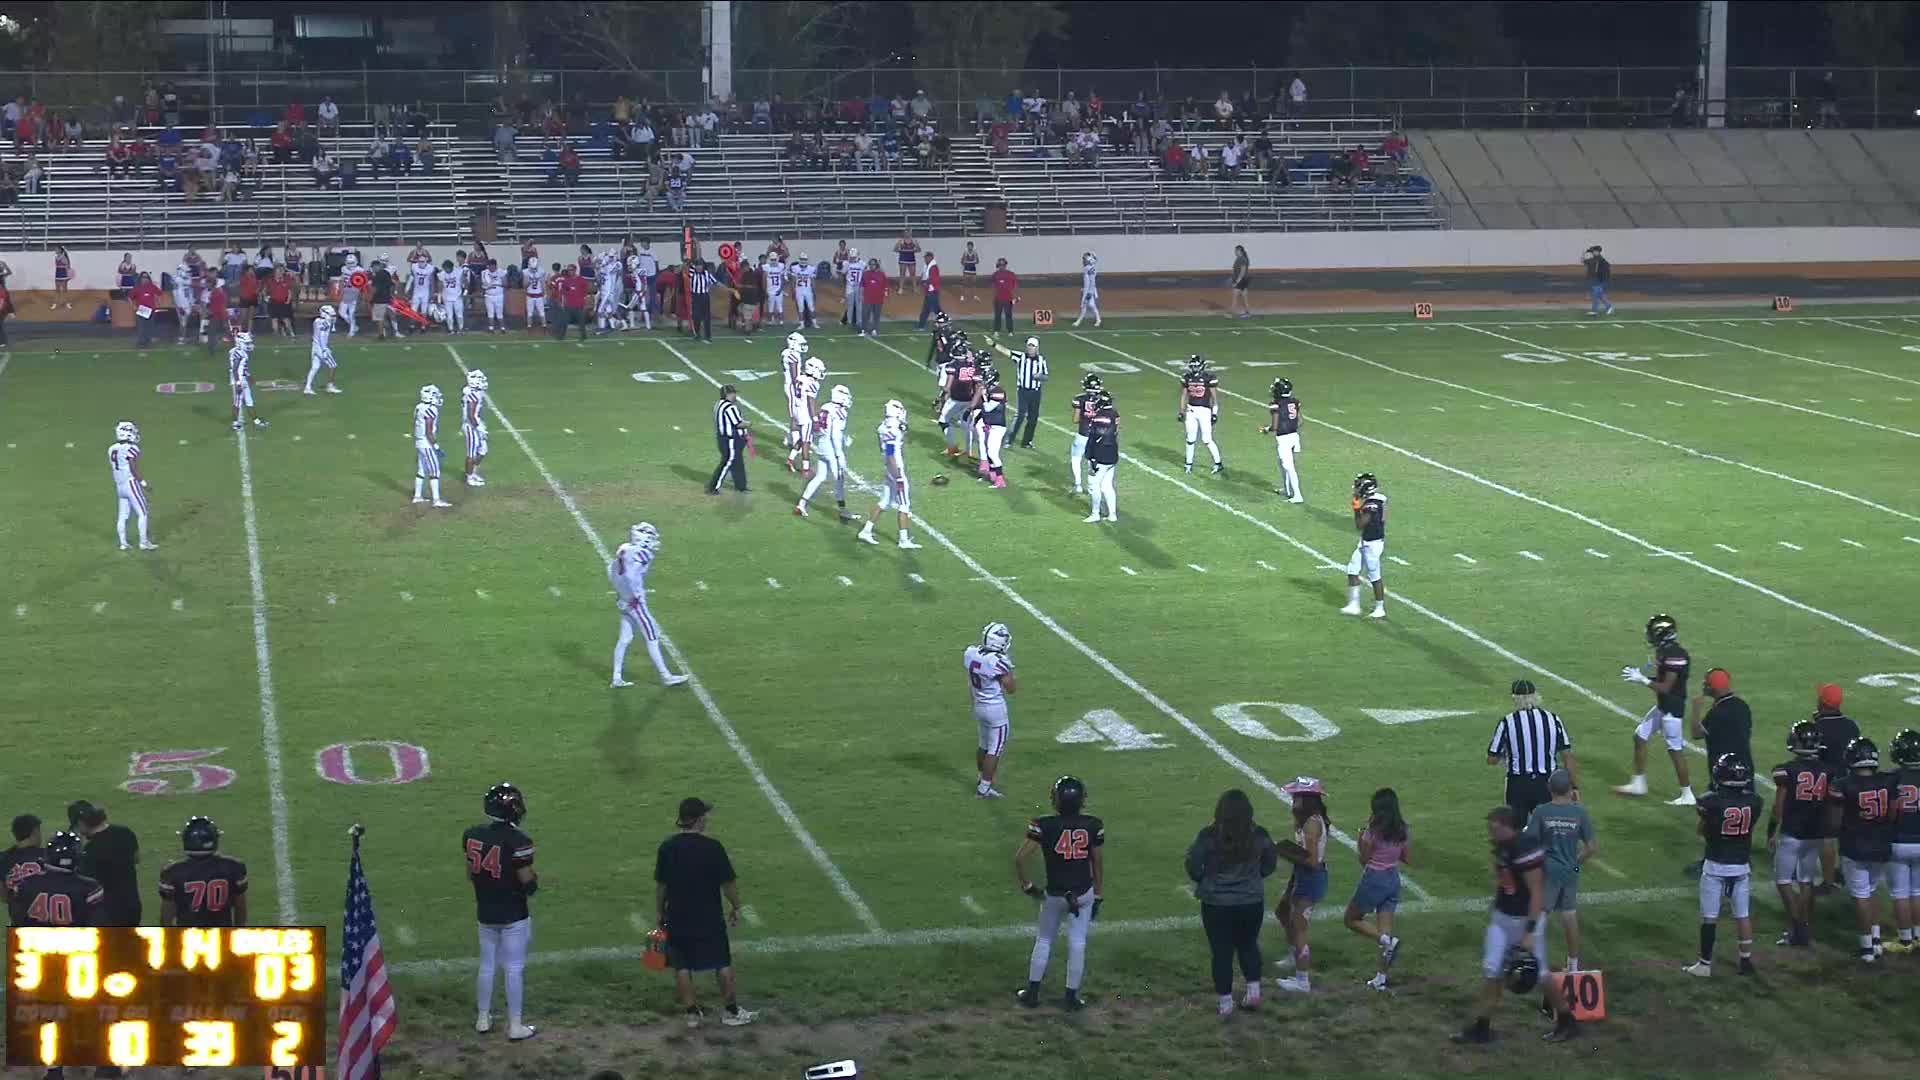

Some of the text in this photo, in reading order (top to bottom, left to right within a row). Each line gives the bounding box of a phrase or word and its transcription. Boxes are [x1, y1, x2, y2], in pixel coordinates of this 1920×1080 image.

[1037, 310, 1051, 322] 30
[1418, 303, 1431, 315] 20
[1796, 771, 1827, 801] 24
[1897, 784, 1920, 812] 2
[1858, 788, 1889, 820] 51
[1721, 806, 1752, 835] 21
[466, 838, 501, 879] 54
[1055, 829, 1089, 860] 42
[27, 892, 73, 925] 40
[185, 879, 229, 912] 70
